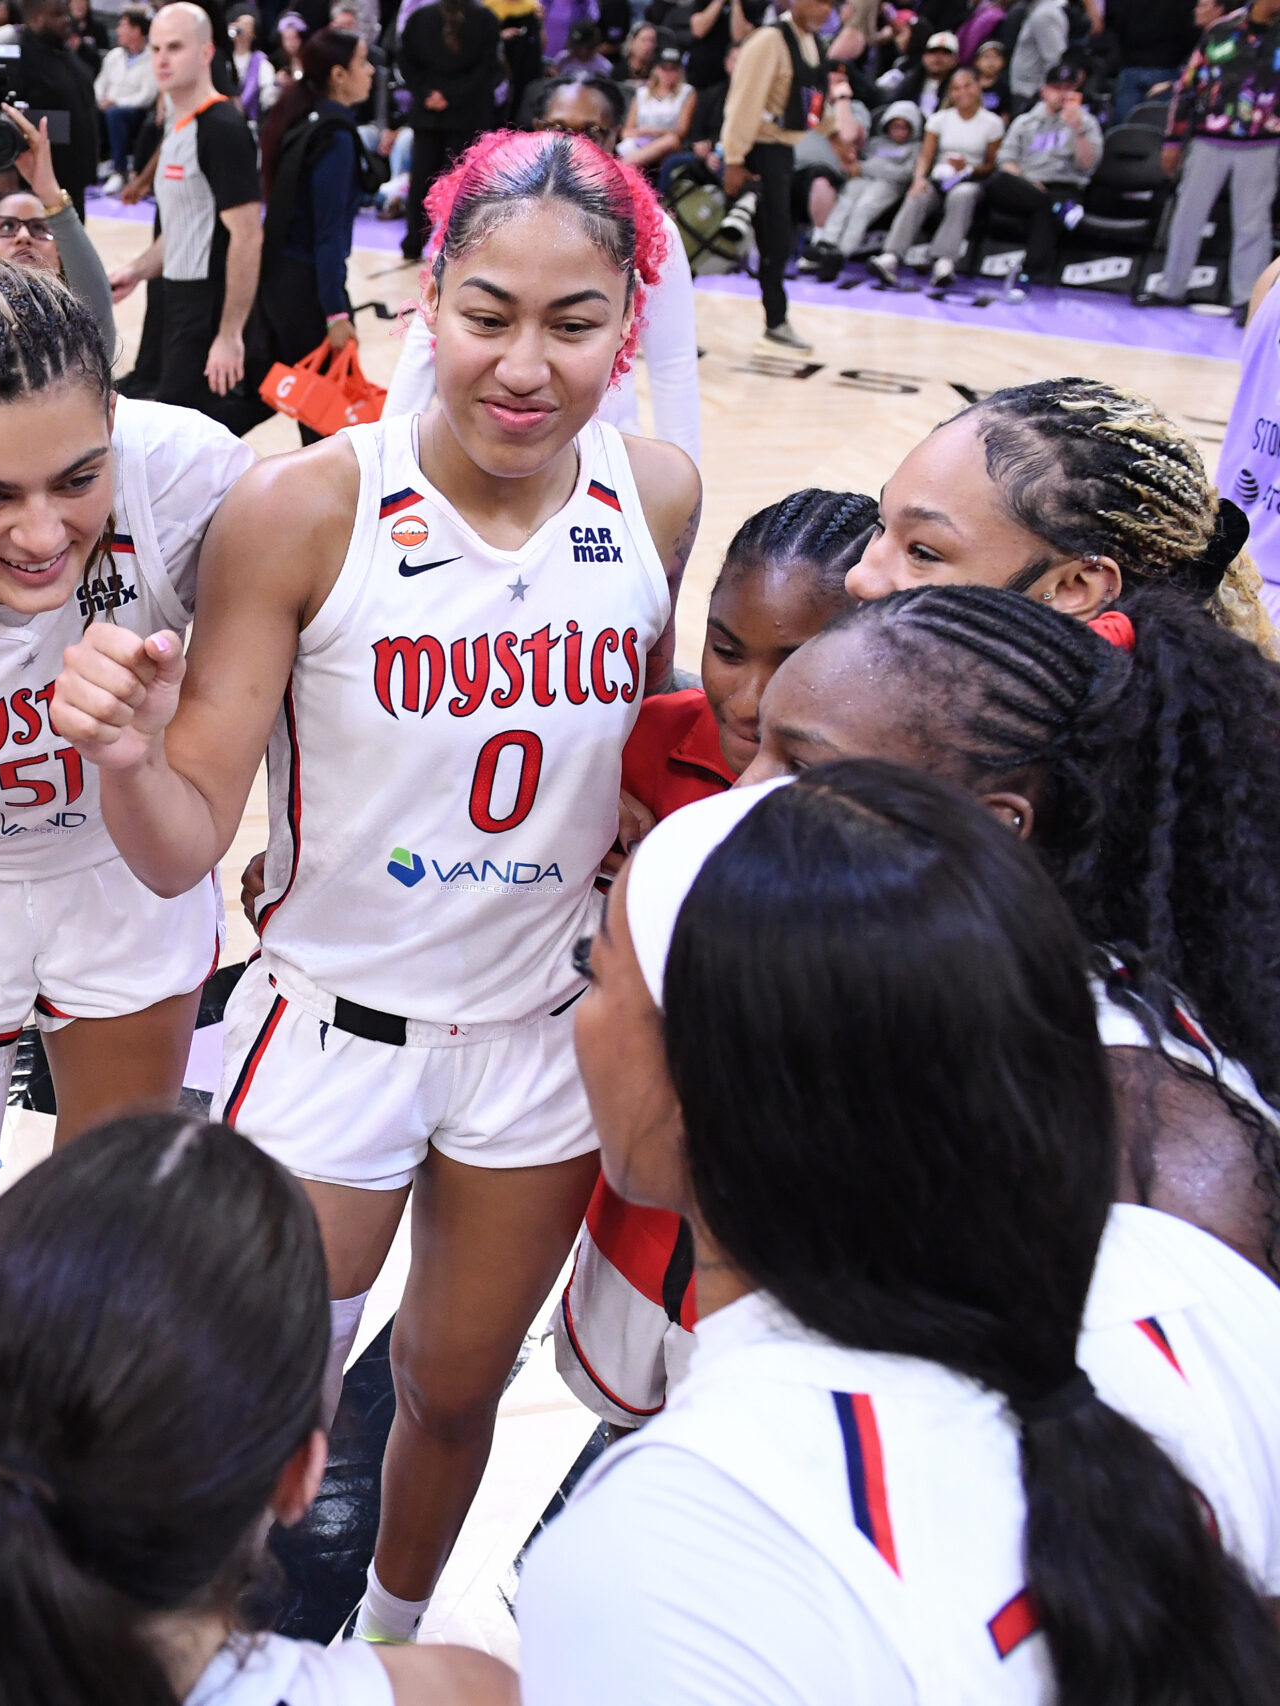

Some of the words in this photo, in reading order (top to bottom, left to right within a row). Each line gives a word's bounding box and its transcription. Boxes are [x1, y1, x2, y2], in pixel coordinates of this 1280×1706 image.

[569, 525, 613, 544] CAR
[572, 544, 624, 564] max
[468, 729, 544, 834] 0
[431, 859, 564, 885] VANDA
